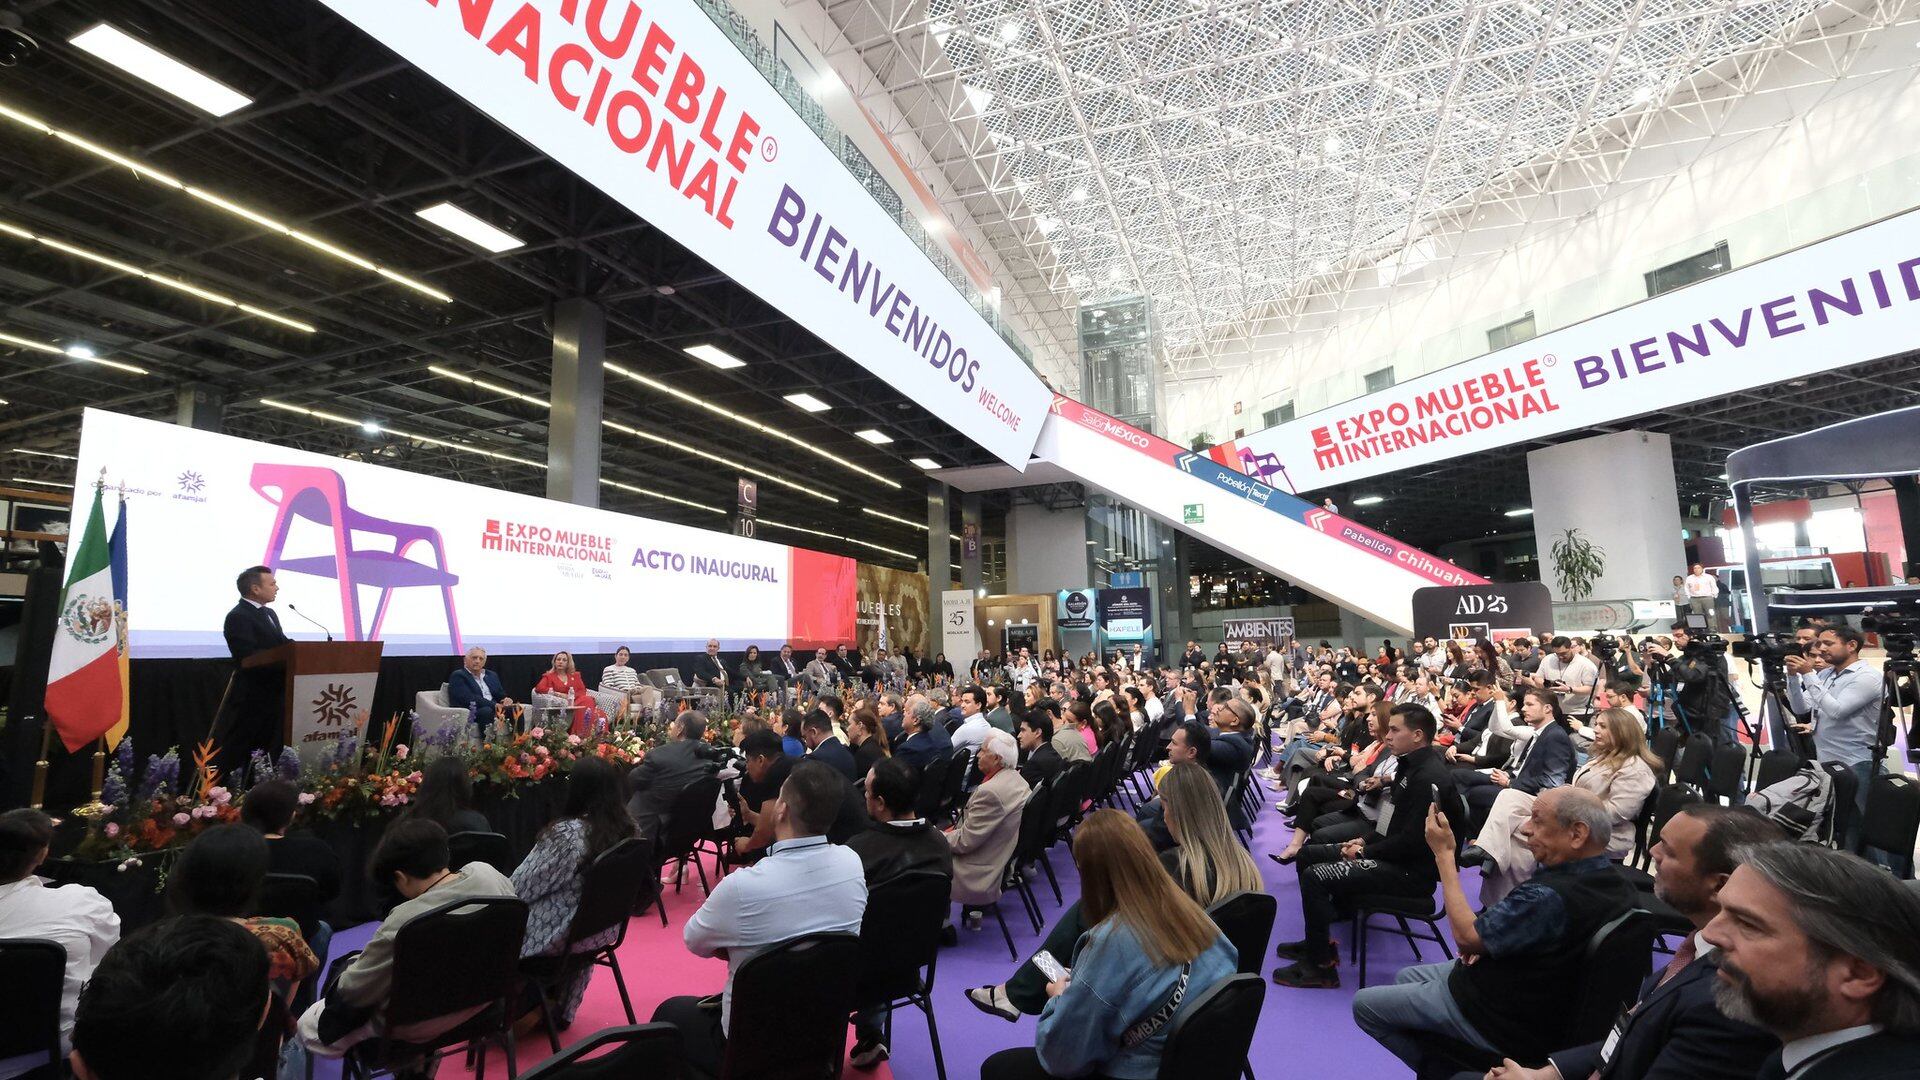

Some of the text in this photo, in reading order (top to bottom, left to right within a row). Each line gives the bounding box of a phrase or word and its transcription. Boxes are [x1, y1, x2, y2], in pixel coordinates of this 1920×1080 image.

[560, 0, 761, 174] UEBLE
[767, 183, 1021, 432] BIENVENIDOS WELCOME
[1336, 359, 1545, 441] EXPO MUEBLE
[1104, 423, 1149, 448] MÉXICO
[1344, 388, 1560, 463] INTERNACIONAL
[744, 484, 752, 503] C
[1216, 472, 1251, 496] Pabellón
[506, 522, 611, 550] EXPO MUEBLE
[741, 518, 753, 537] 10
[505, 539, 613, 563] INTERNACIONAL
[1343, 528, 1476, 586] Pabellón Chihuah
[632, 548, 778, 583] ACTO INAUGURAL
[1455, 595, 1485, 615] AD
[1226, 621, 1293, 638] AMBIENTES
[1167, 974, 1189, 1011] LOLA
